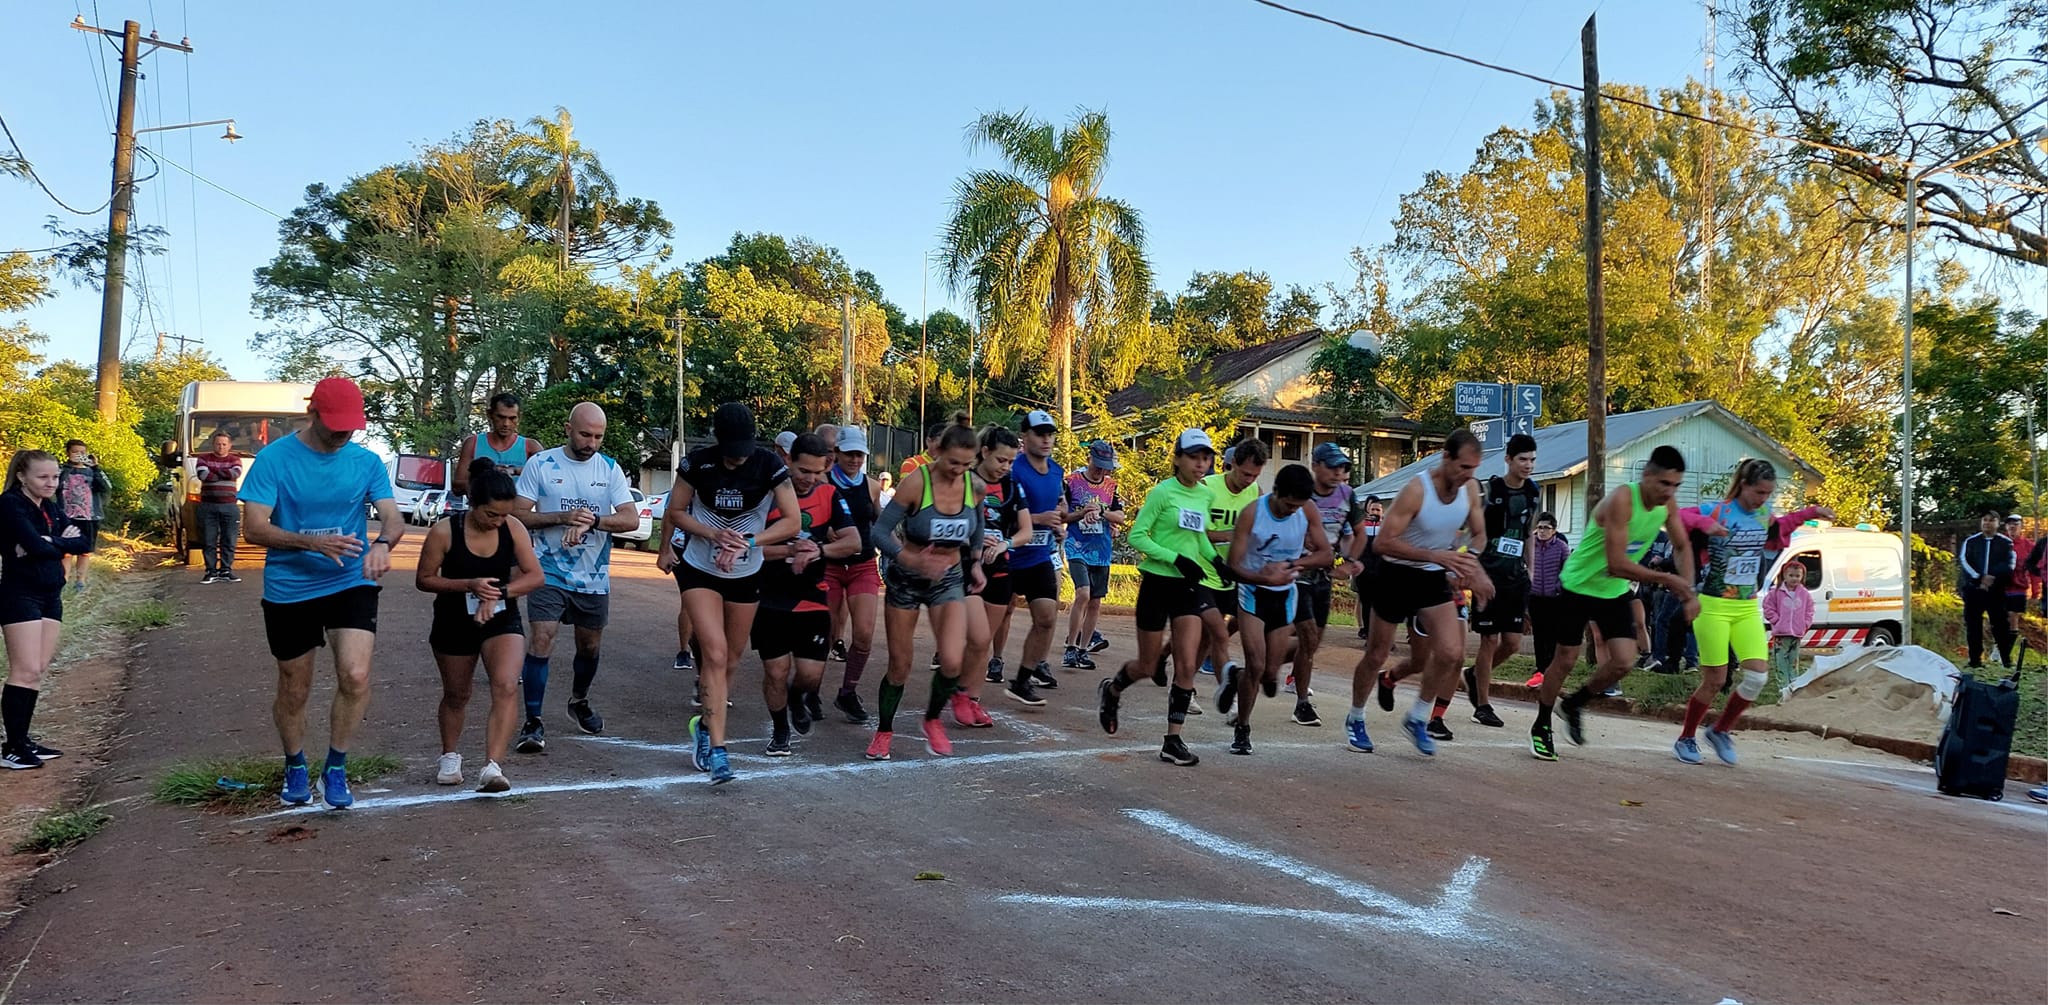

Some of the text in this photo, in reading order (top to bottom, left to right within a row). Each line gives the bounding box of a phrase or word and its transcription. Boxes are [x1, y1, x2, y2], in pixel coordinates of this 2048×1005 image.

[1458, 385, 1494, 395] Pan Pam
[1458, 395, 1488, 406] Olejnik
[1472, 424, 1489, 432] Pablo
[933, 524, 965, 538] 390
